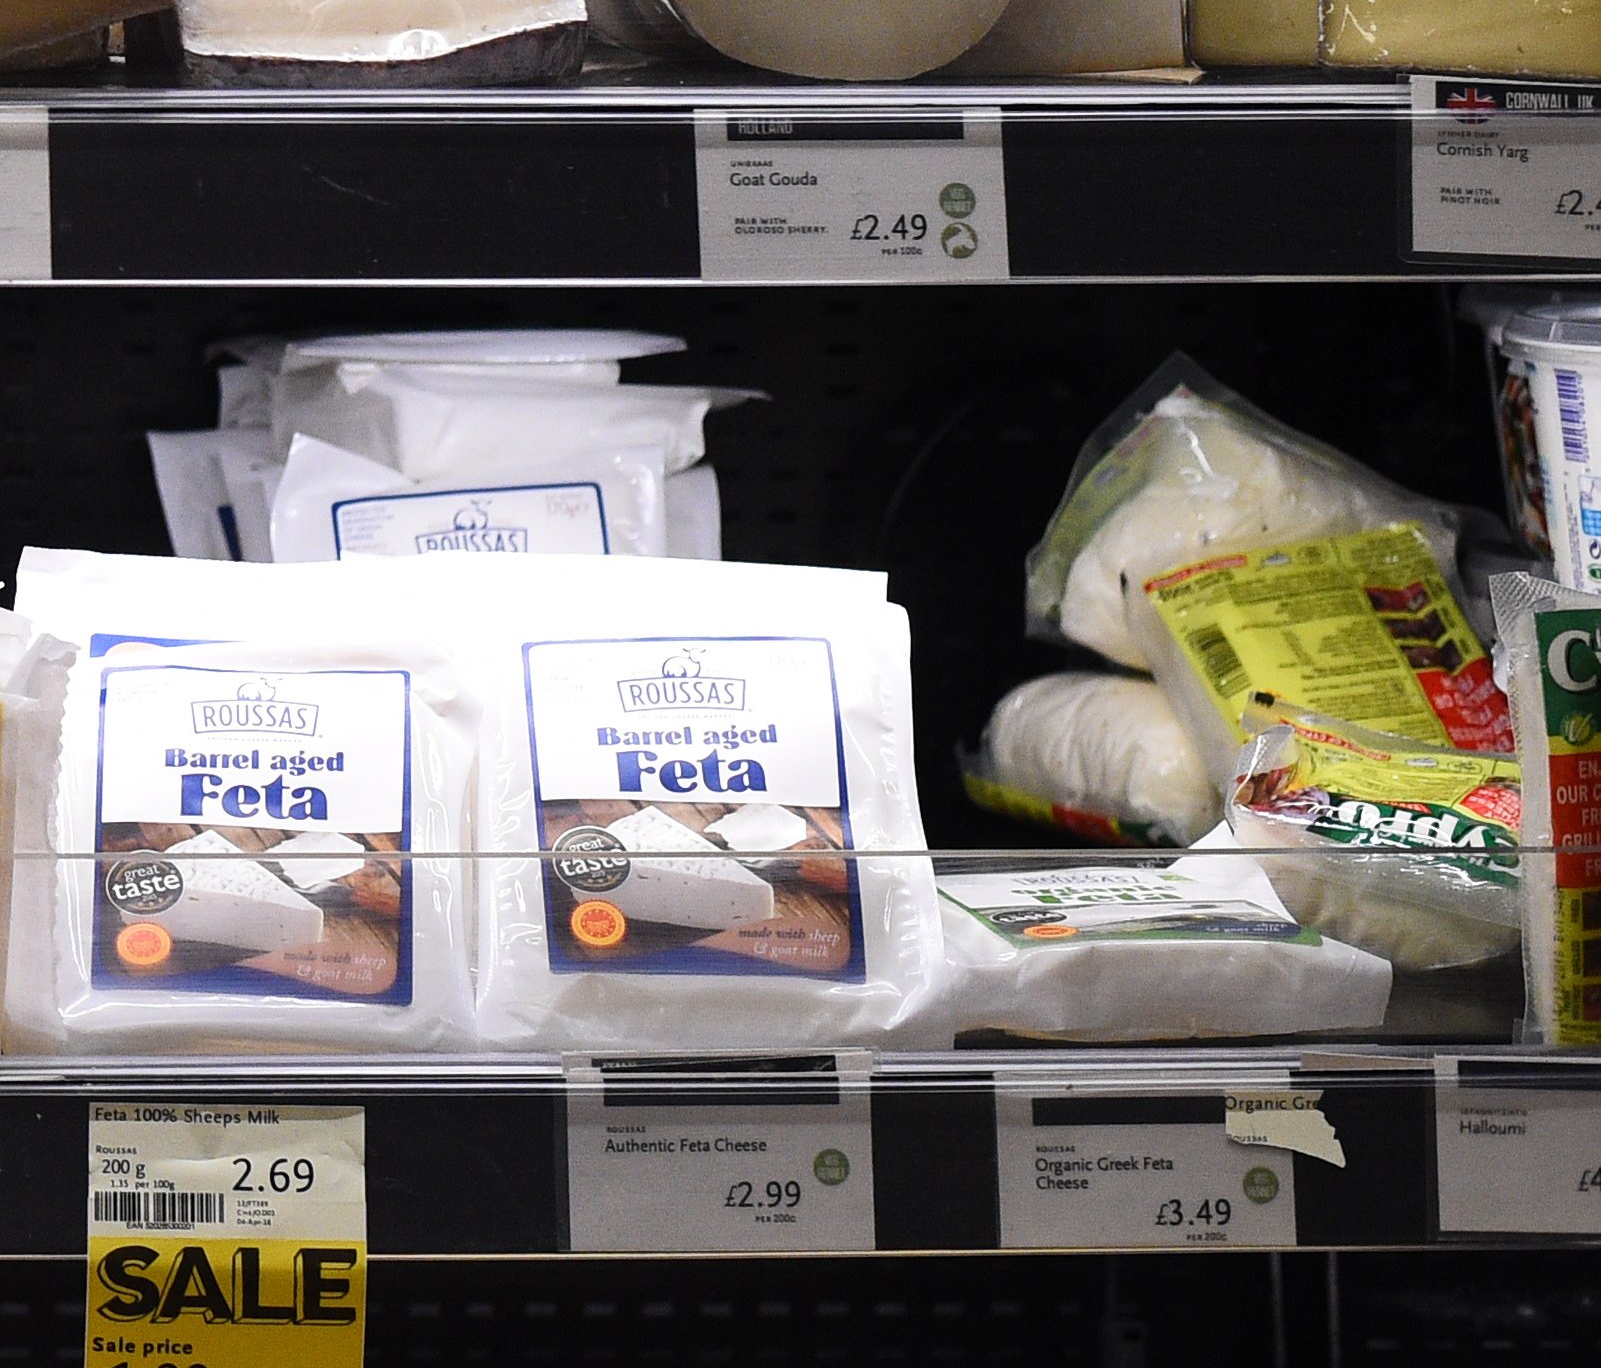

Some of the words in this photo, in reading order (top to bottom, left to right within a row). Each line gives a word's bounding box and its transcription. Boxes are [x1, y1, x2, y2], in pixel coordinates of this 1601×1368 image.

[1436, 142, 1492, 157] Cornish
[1497, 144, 1529, 163] Yarg
[730, 172, 765, 186] Goat
[769, 171, 818, 186] Gouda
[849, 214, 928, 241] £2.49
[630, 681, 735, 706] ROUSSAS
[203, 704, 308, 730] ROUSSAS
[596, 726, 692, 747] Barrel
[703, 724, 778, 750] aged
[165, 748, 260, 770] Barrel
[270, 750, 345, 776] aged
[616, 748, 768, 793] Feta
[124, 864, 161, 882] great
[111, 874, 182, 901] taste
[94, 1107, 128, 1123] Feta
[133, 1107, 178, 1124] 100%
[184, 1109, 242, 1128] Sheeps
[247, 1110, 281, 1125] Milk
[1460, 1120, 1528, 1135] Halloumi
[605, 1137, 676, 1153] Authentic
[679, 1138, 711, 1153] Feta
[714, 1137, 768, 1153] Cheese
[101, 1159, 131, 1175] 200
[135, 1163, 146, 1179] g
[232, 1158, 315, 1194] 2.69
[1035, 1157, 1094, 1175] Organic
[1096, 1156, 1141, 1172] Greek
[1143, 1156, 1174, 1171] Feta
[724, 1180, 801, 1208] £2.99
[1035, 1175, 1089, 1192] Cheese
[1155, 1198, 1232, 1226] £3.49
[97, 1245, 358, 1326] SALE
[92, 1336, 136, 1355] Sale
[143, 1338, 194, 1358] price
